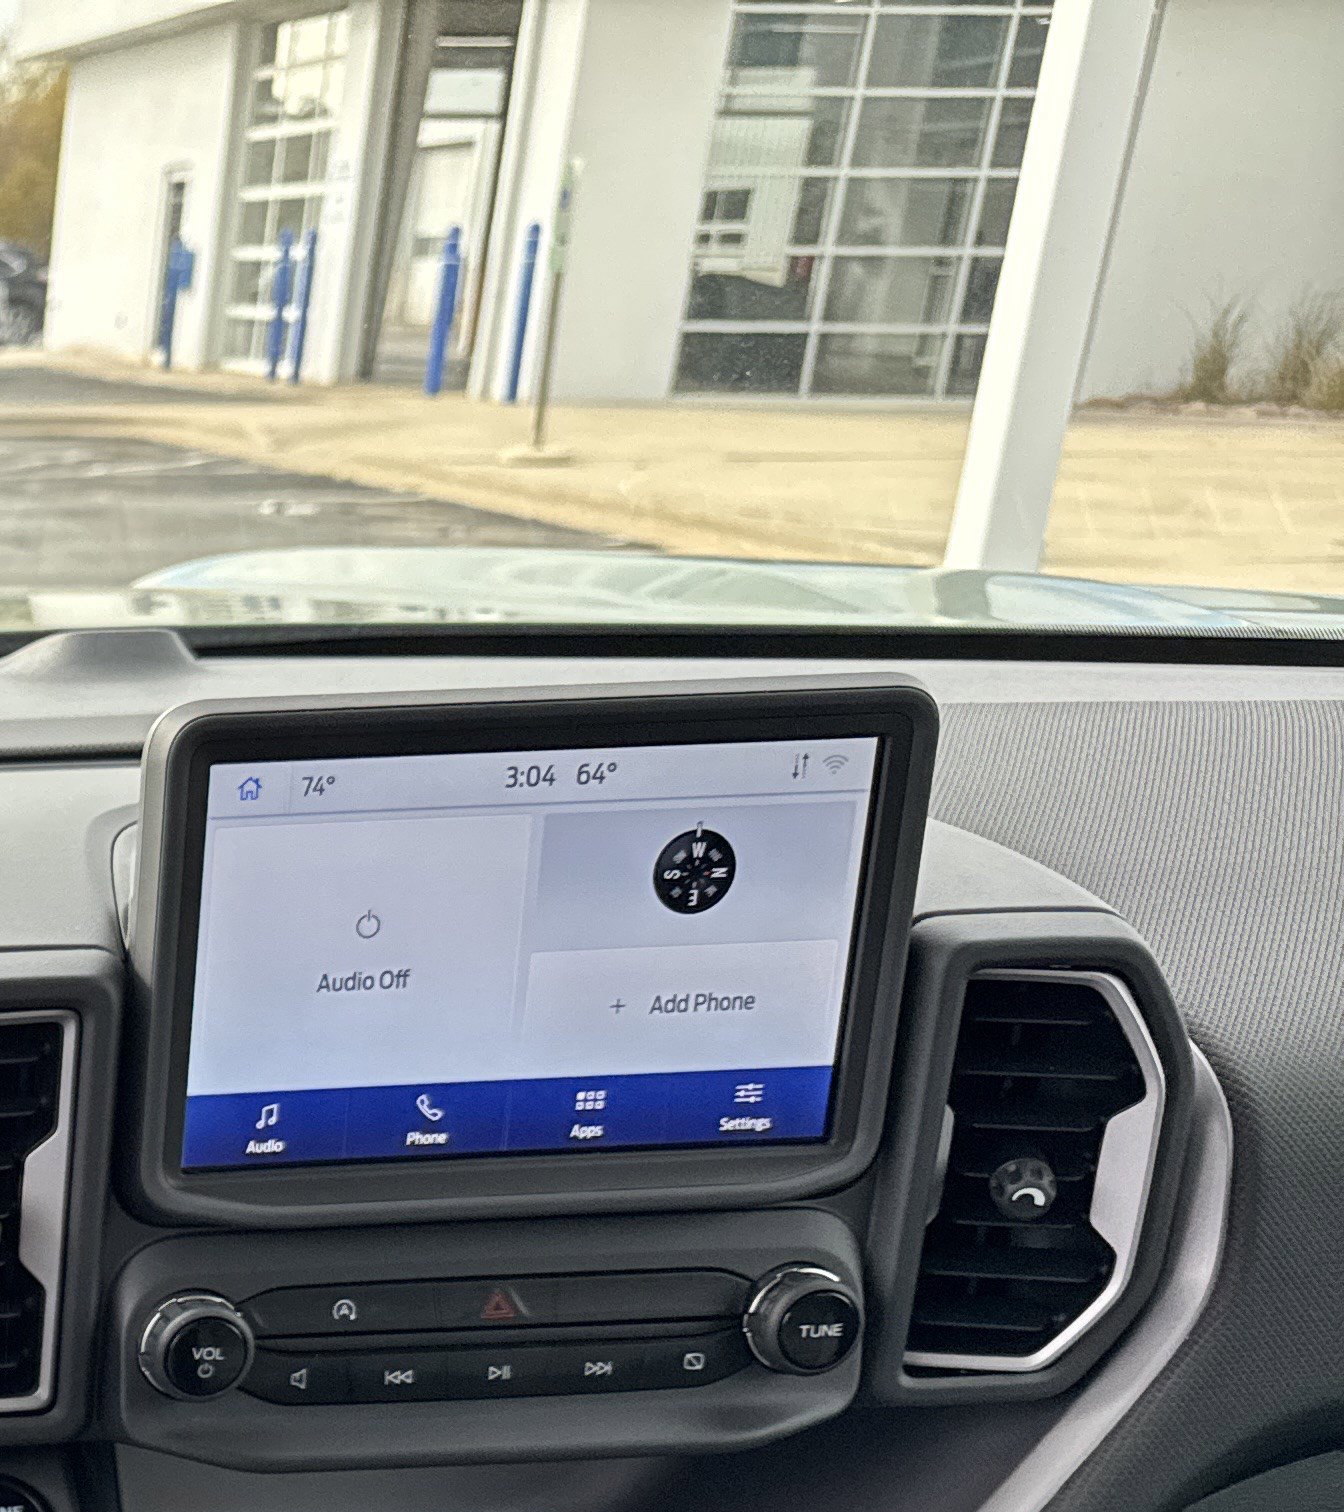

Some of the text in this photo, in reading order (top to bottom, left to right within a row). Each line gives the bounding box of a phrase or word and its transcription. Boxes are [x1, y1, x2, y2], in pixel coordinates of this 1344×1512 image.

[505, 765, 556, 788] 3:04
[692, 842, 707, 858] W
[316, 969, 411, 993] Audio Off
[648, 993, 756, 1015] Add Phone
[569, 1124, 604, 1139] Apps
[719, 1117, 772, 1132] Settings
[406, 1131, 449, 1146] Phone
[246, 1139, 285, 1154] Audio
[799, 1323, 844, 1339] TUNE
[192, 1347, 224, 1361] VOL
